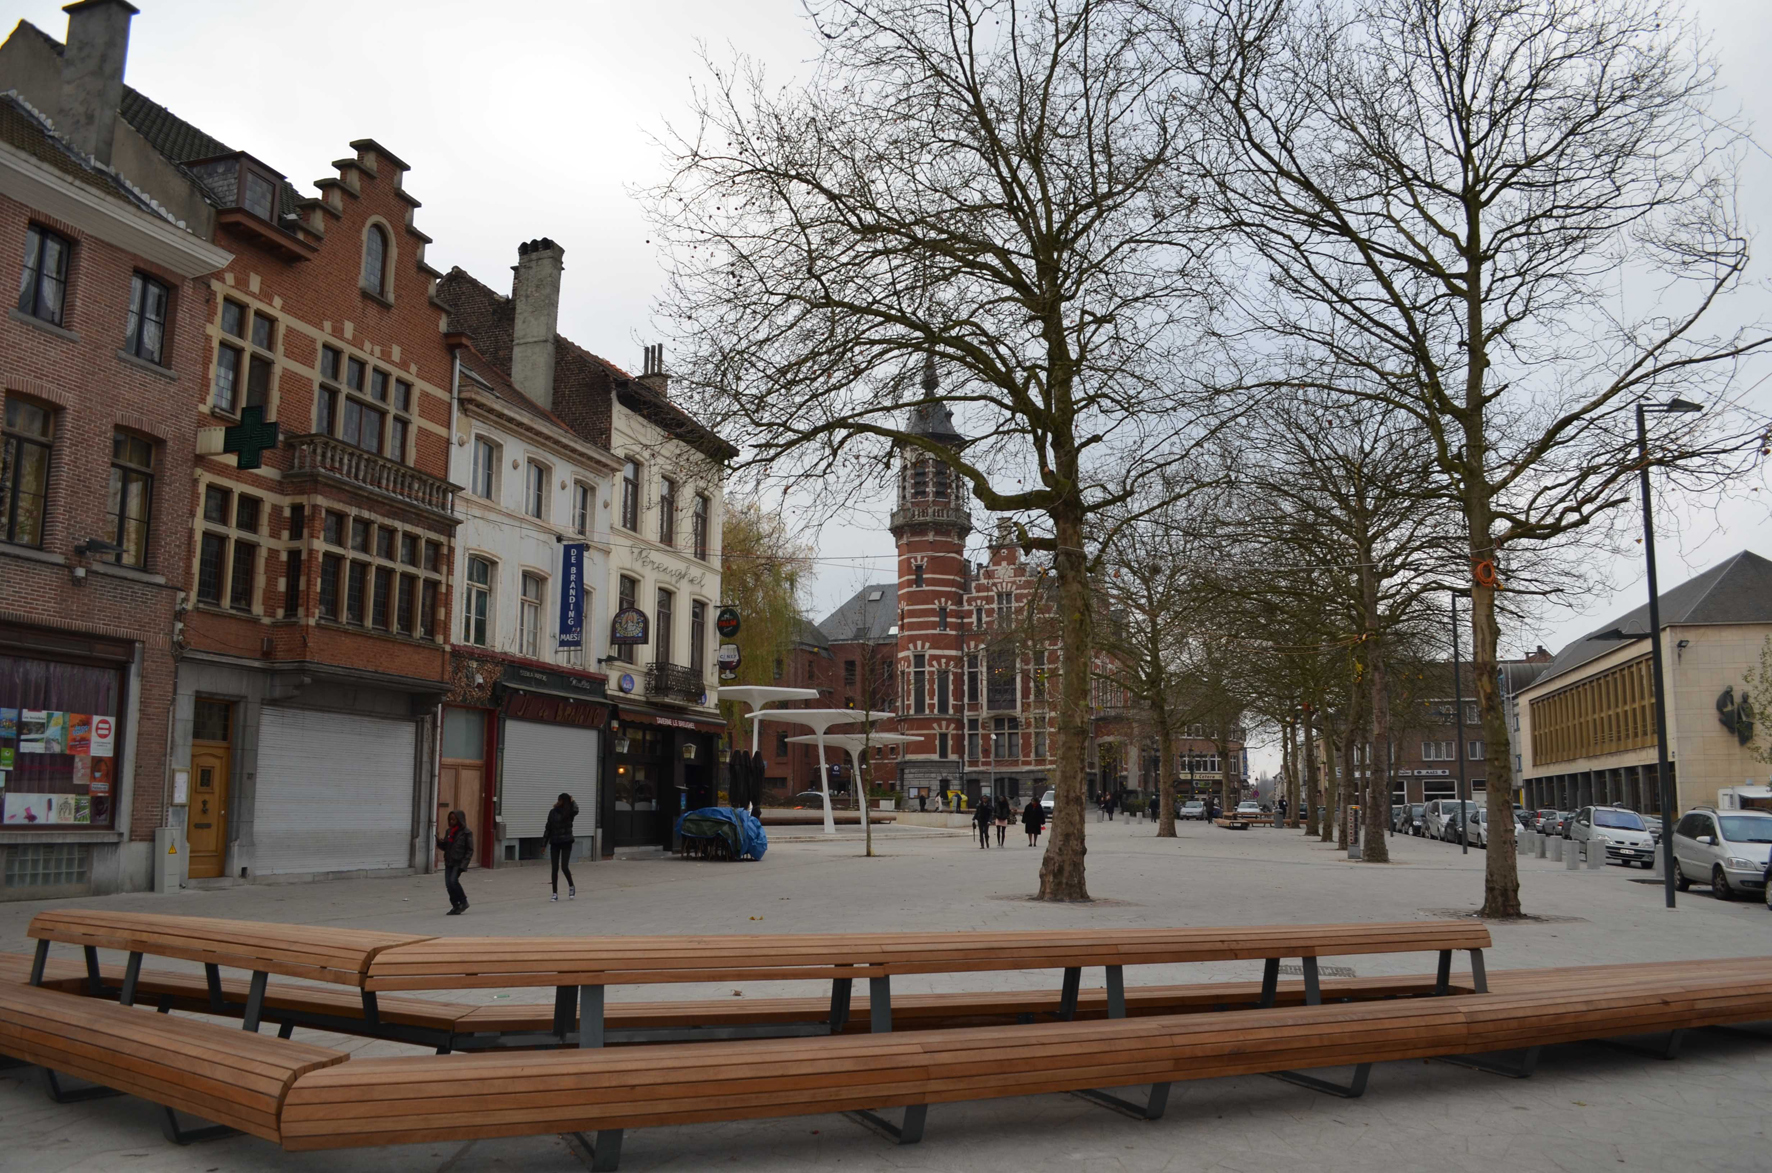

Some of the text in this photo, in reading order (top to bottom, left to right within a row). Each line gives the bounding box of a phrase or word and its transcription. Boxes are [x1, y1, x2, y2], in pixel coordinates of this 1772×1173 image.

[631, 544, 706, 588] Breughel
[567, 548, 577, 626] DE BRANDING
[560, 633, 578, 641] MAES
[656, 716, 673, 726] TAVERNE
[673, 719, 678, 727] LE
